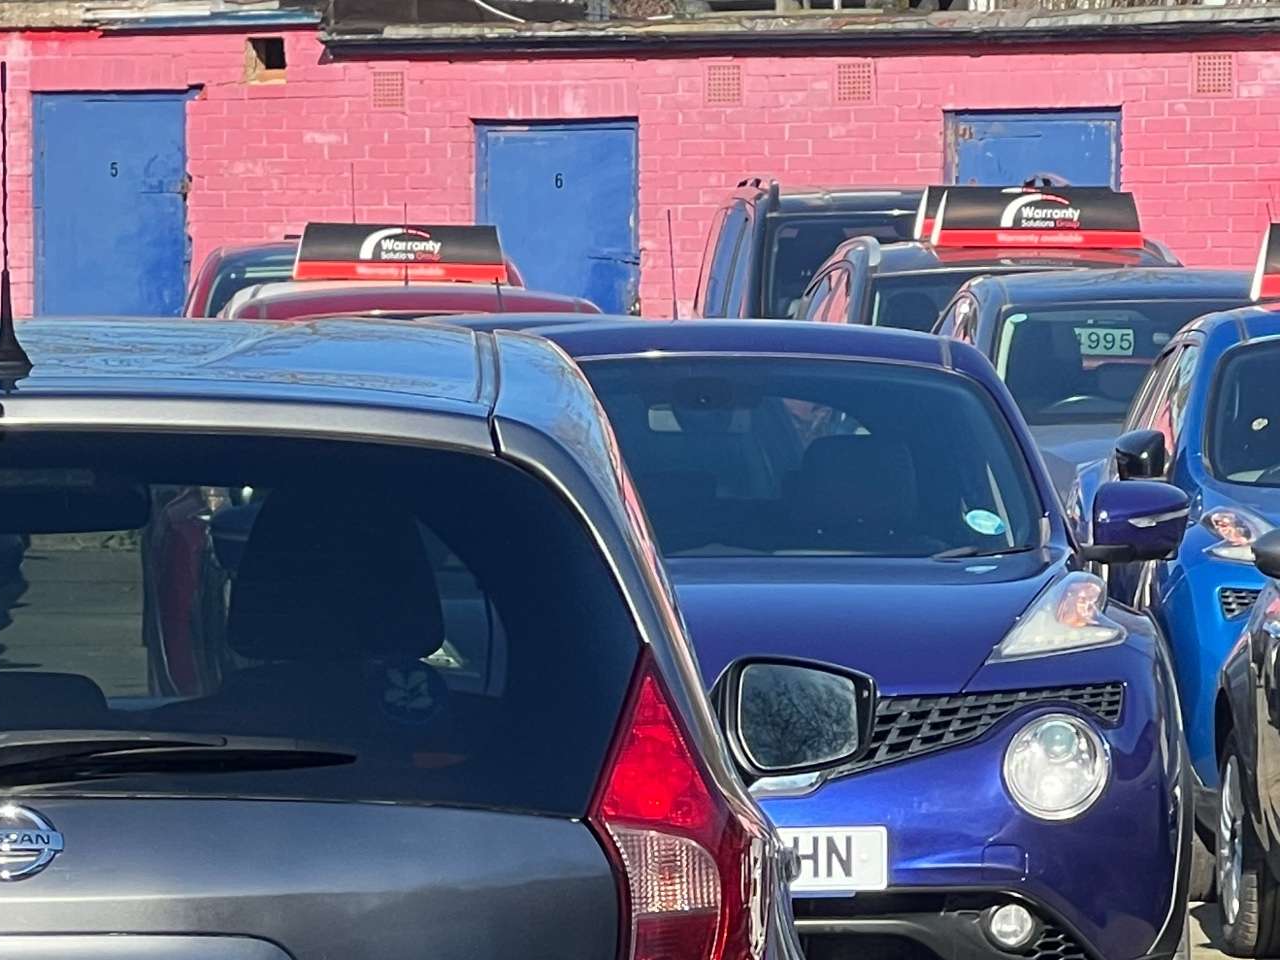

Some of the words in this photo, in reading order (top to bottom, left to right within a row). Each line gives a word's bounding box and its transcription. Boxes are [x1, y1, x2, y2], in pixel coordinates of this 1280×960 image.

[110, 161, 118, 178] 5
[555, 172, 564, 189] 6
[1021, 206, 1081, 221] Warranty
[1021, 219, 1055, 227] Solutions
[380, 239, 442, 254] Warranty
